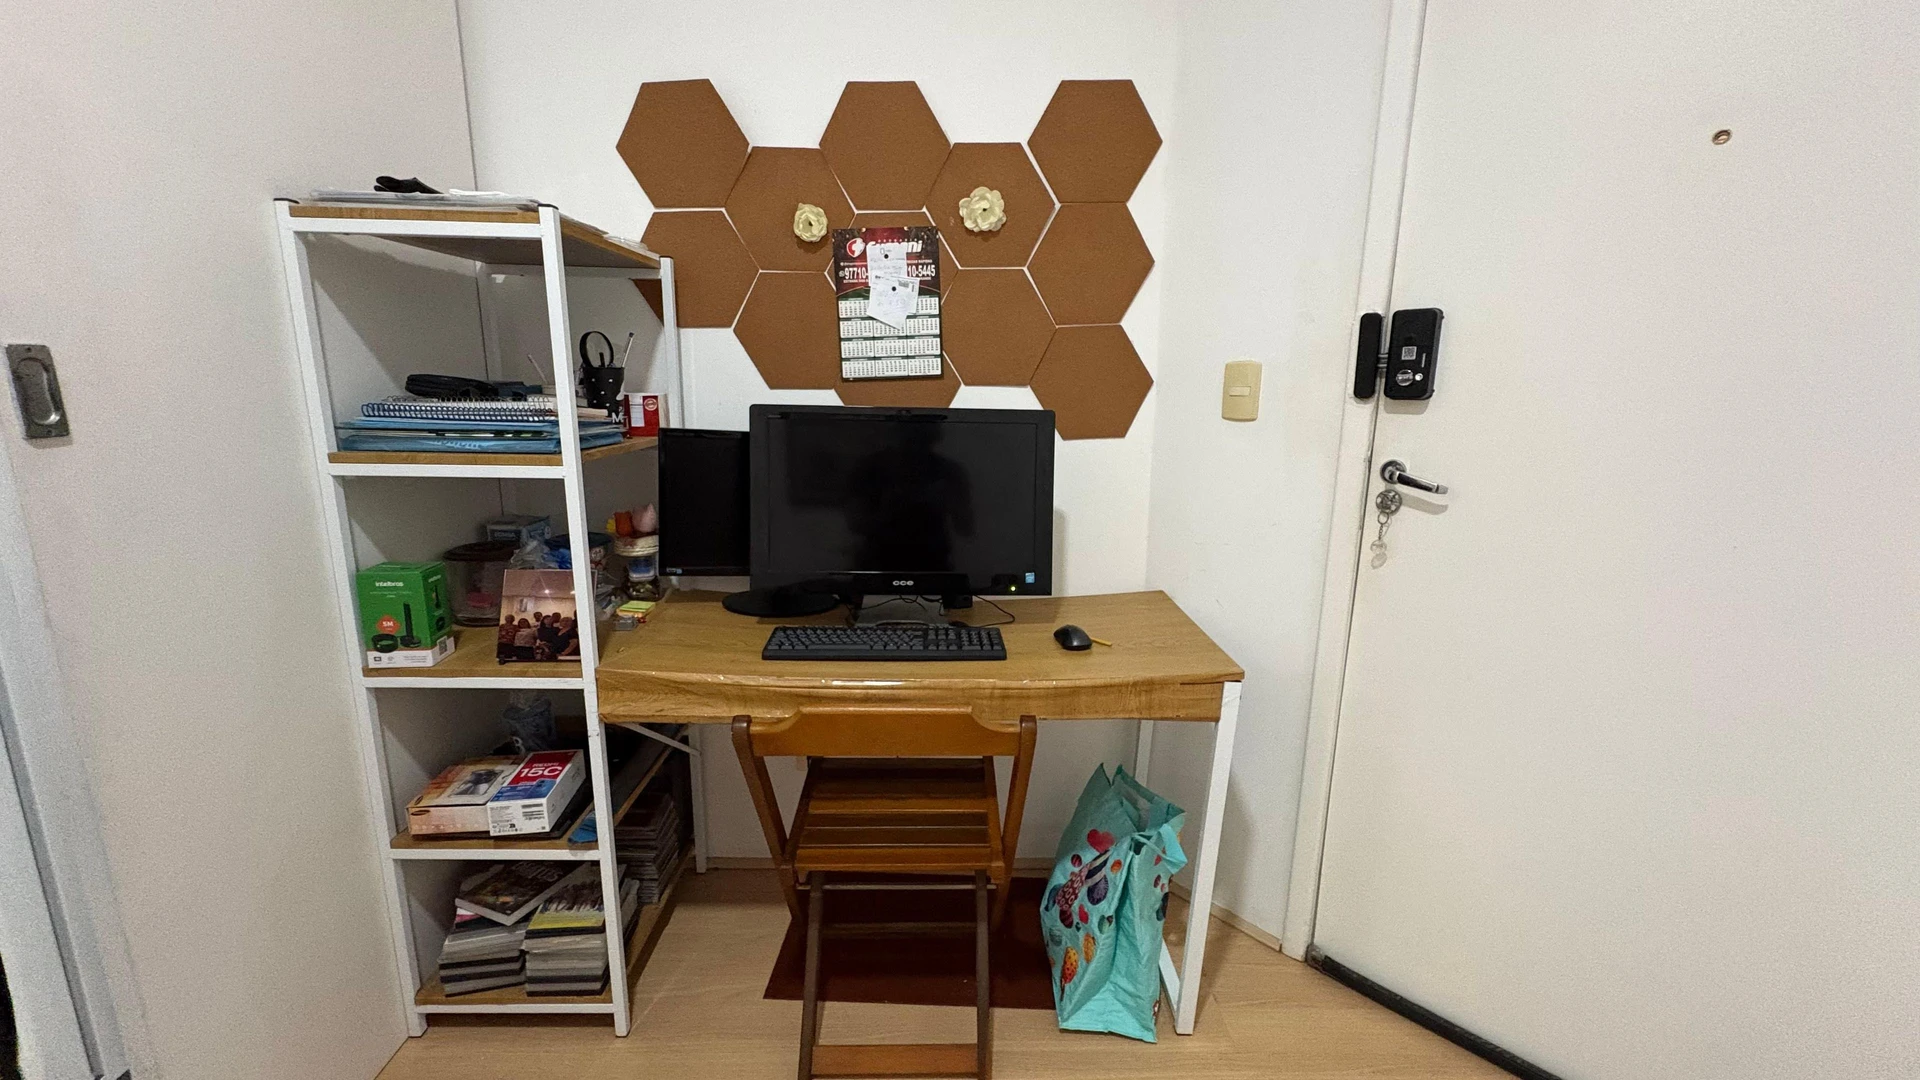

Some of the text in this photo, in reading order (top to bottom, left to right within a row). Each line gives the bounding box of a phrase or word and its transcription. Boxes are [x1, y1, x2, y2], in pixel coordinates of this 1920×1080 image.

[844, 266, 869, 280] 97710-
[907, 264, 936, 278] 10-5445
[520, 766, 562, 778] 15C
